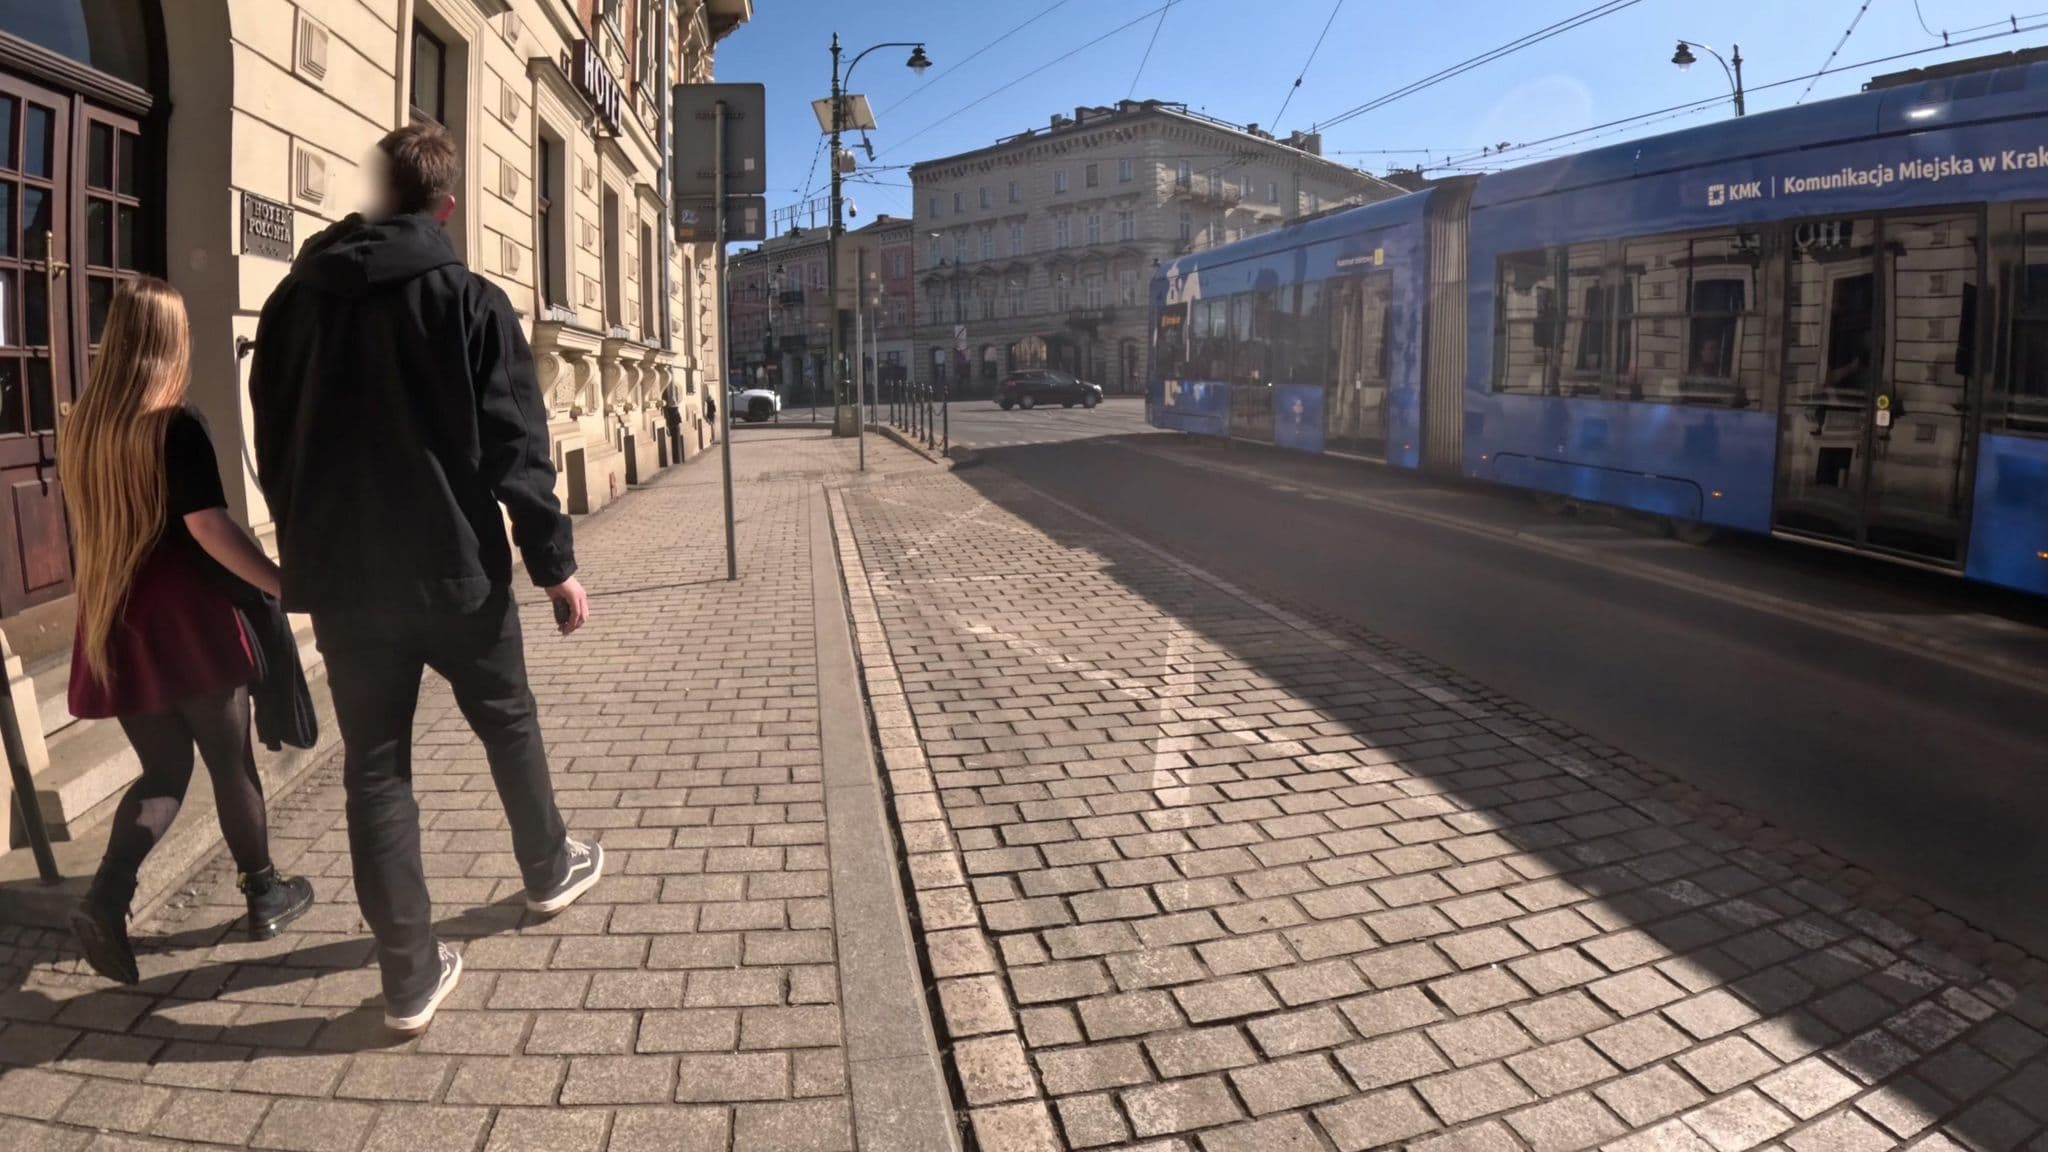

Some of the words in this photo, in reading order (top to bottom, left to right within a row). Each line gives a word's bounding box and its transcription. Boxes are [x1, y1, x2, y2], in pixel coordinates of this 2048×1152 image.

[584, 40, 623, 136] HOTEL
[1729, 181, 1762, 201] KMK
[1784, 164, 1894, 193] Komunikacja
[1899, 154, 1974, 182] Miejska
[1978, 155, 1996, 172] w
[248, 218, 291, 243] POLONIA
[253, 202, 286, 225] HOTEL
